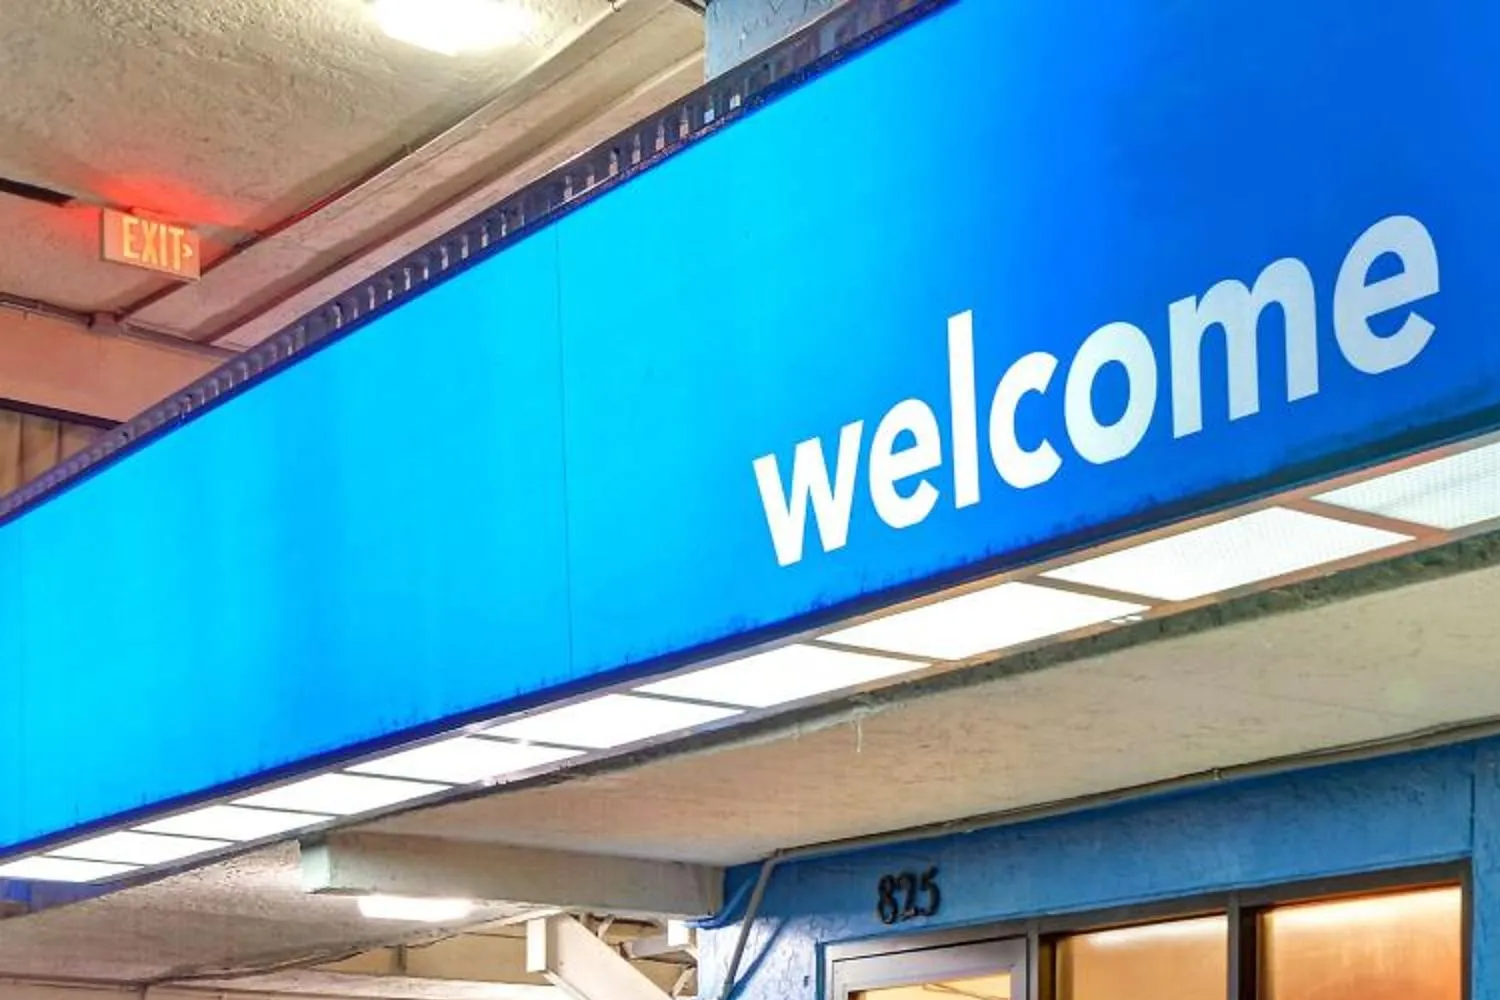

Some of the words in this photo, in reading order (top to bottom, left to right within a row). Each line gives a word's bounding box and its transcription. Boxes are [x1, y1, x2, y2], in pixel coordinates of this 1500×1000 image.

[122, 216, 184, 271] EXIT
[752, 215, 1440, 567] welcome
[878, 866, 941, 924] 825
